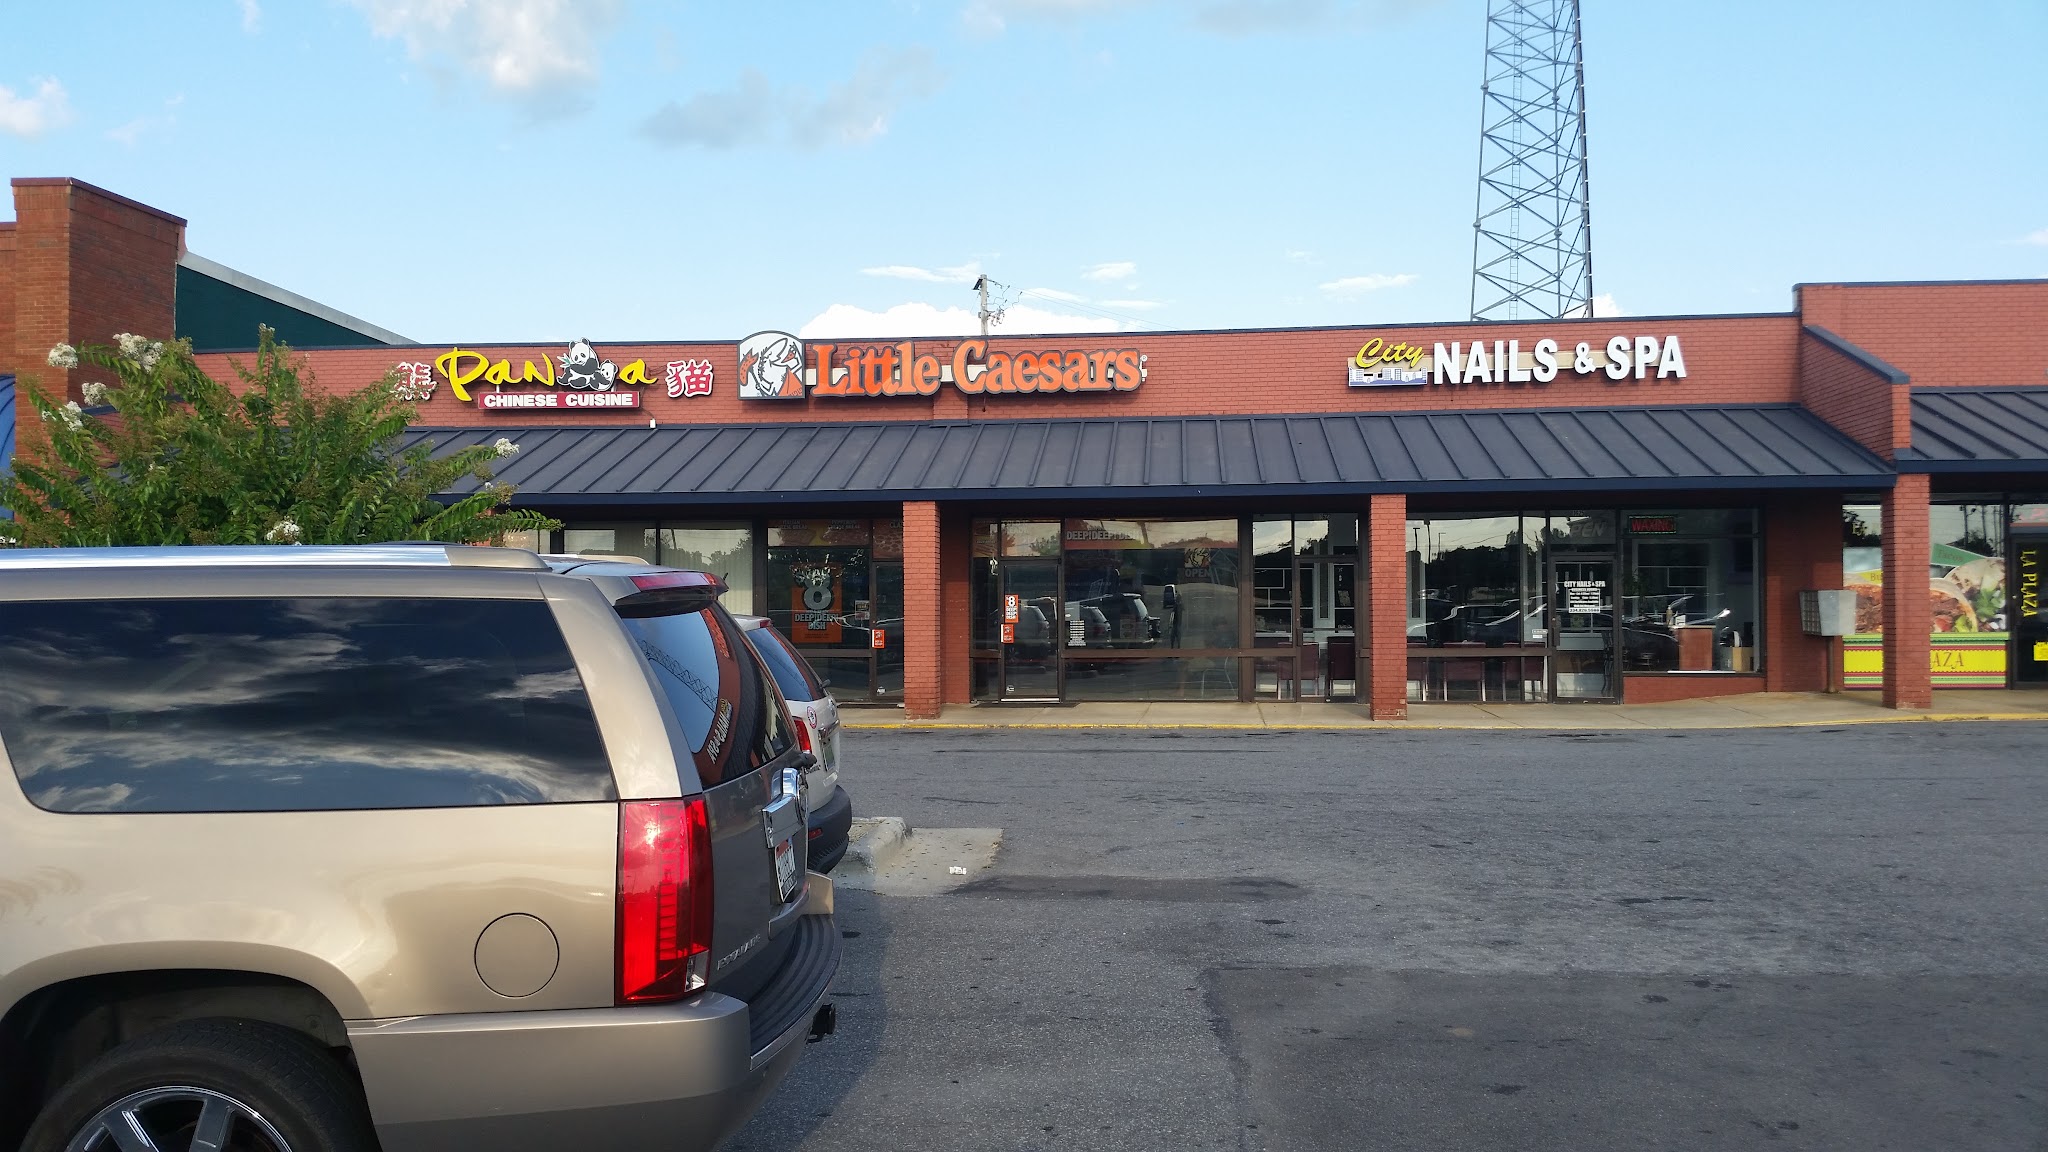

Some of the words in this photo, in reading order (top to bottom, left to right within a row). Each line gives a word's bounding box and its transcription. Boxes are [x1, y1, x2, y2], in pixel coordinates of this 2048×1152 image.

[435, 346, 658, 401] PaNa
[811, 339, 943, 397] Little
[951, 338, 1142, 395] Caesars
[1355, 337, 1424, 369] City
[1433, 338, 1558, 385] NAILS
[1574, 342, 1597, 375] &
[1605, 335, 1687, 380] SPA
[483, 393, 558, 408] CHINESE
[565, 393, 634, 408] CUISINE
[2020, 550, 2037, 567] LA
[1563, 580, 1577, 588] CITY
[2020, 573, 2039, 617] PLAZA
[1929, 651, 1964, 670] AZA
